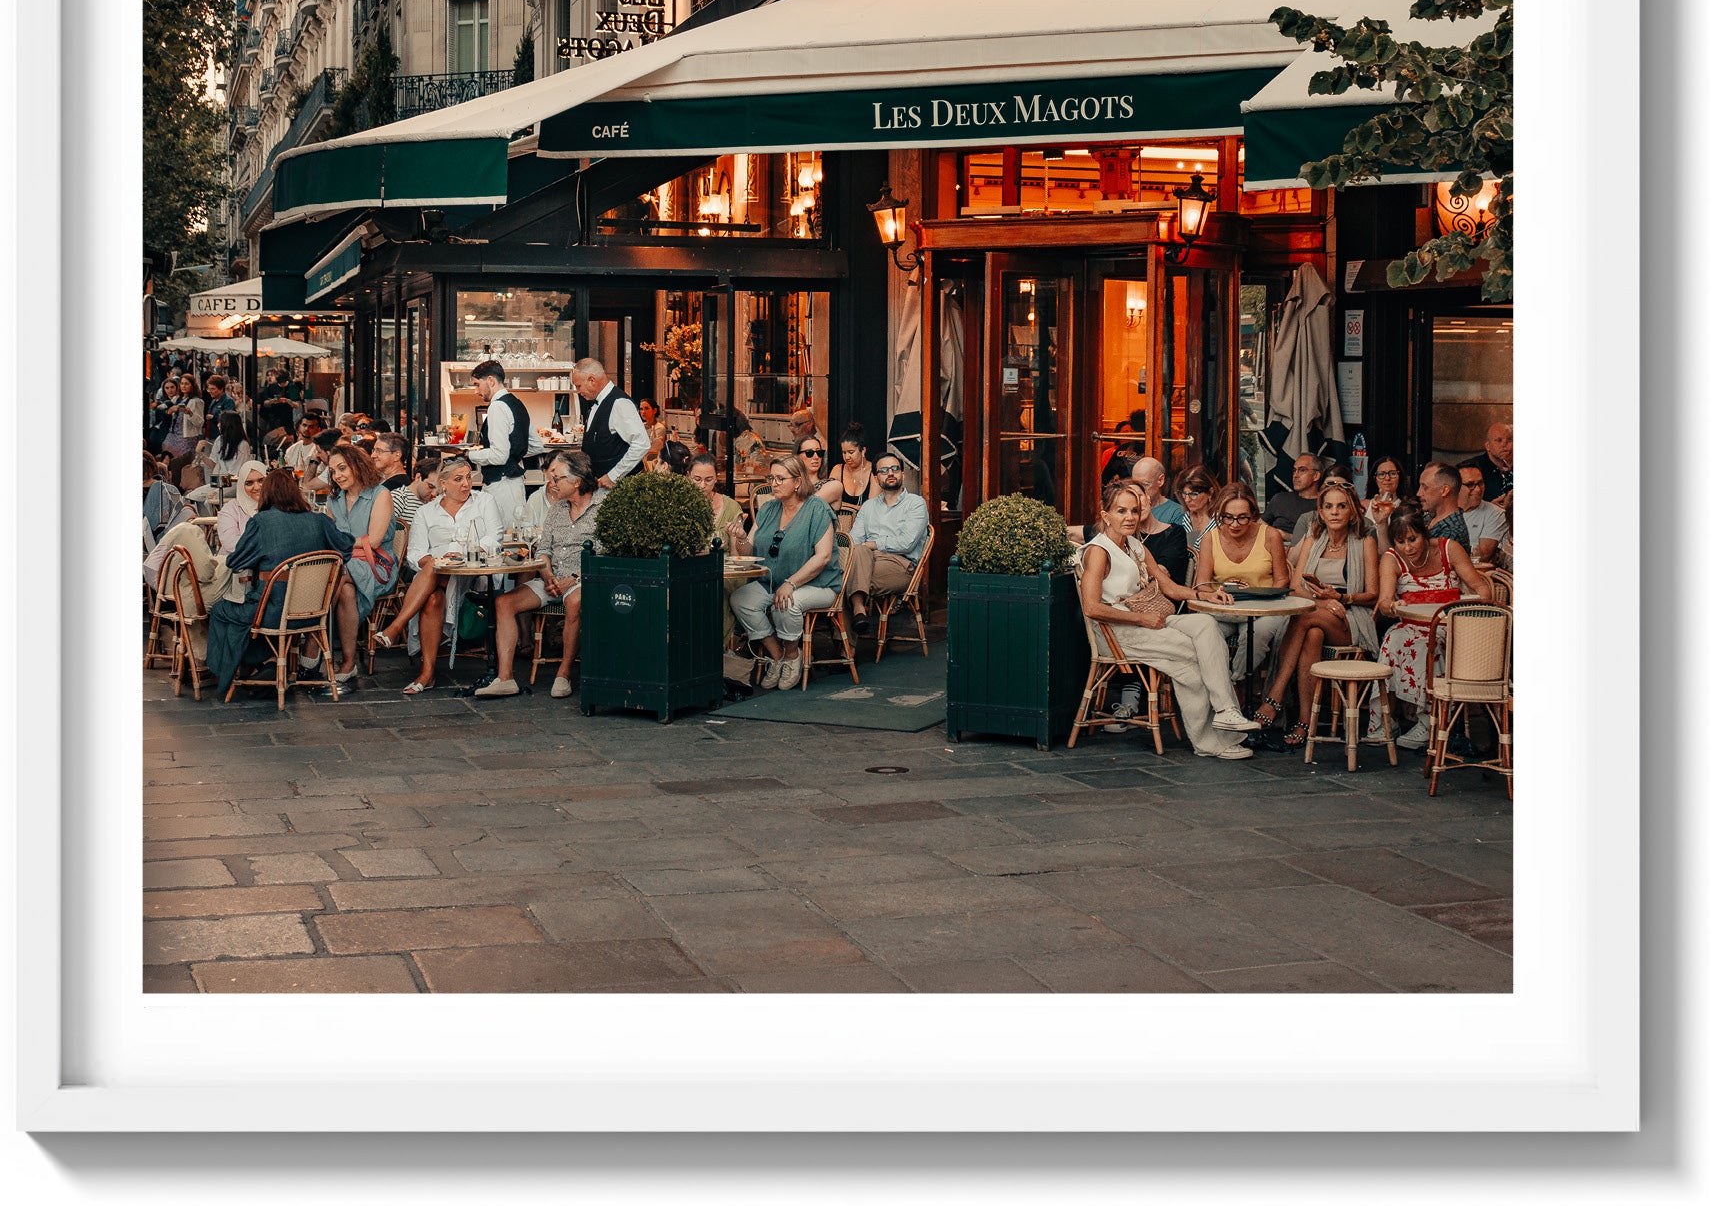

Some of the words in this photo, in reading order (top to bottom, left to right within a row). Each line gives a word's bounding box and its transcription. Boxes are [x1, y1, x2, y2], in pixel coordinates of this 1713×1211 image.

[872, 102, 922, 130] LES
[931, 99, 1007, 128] DEUX
[1013, 94, 1134, 124] MAGOTS
[591, 122, 630, 138] CAFÉ
[197, 298, 236, 311] CAFE
